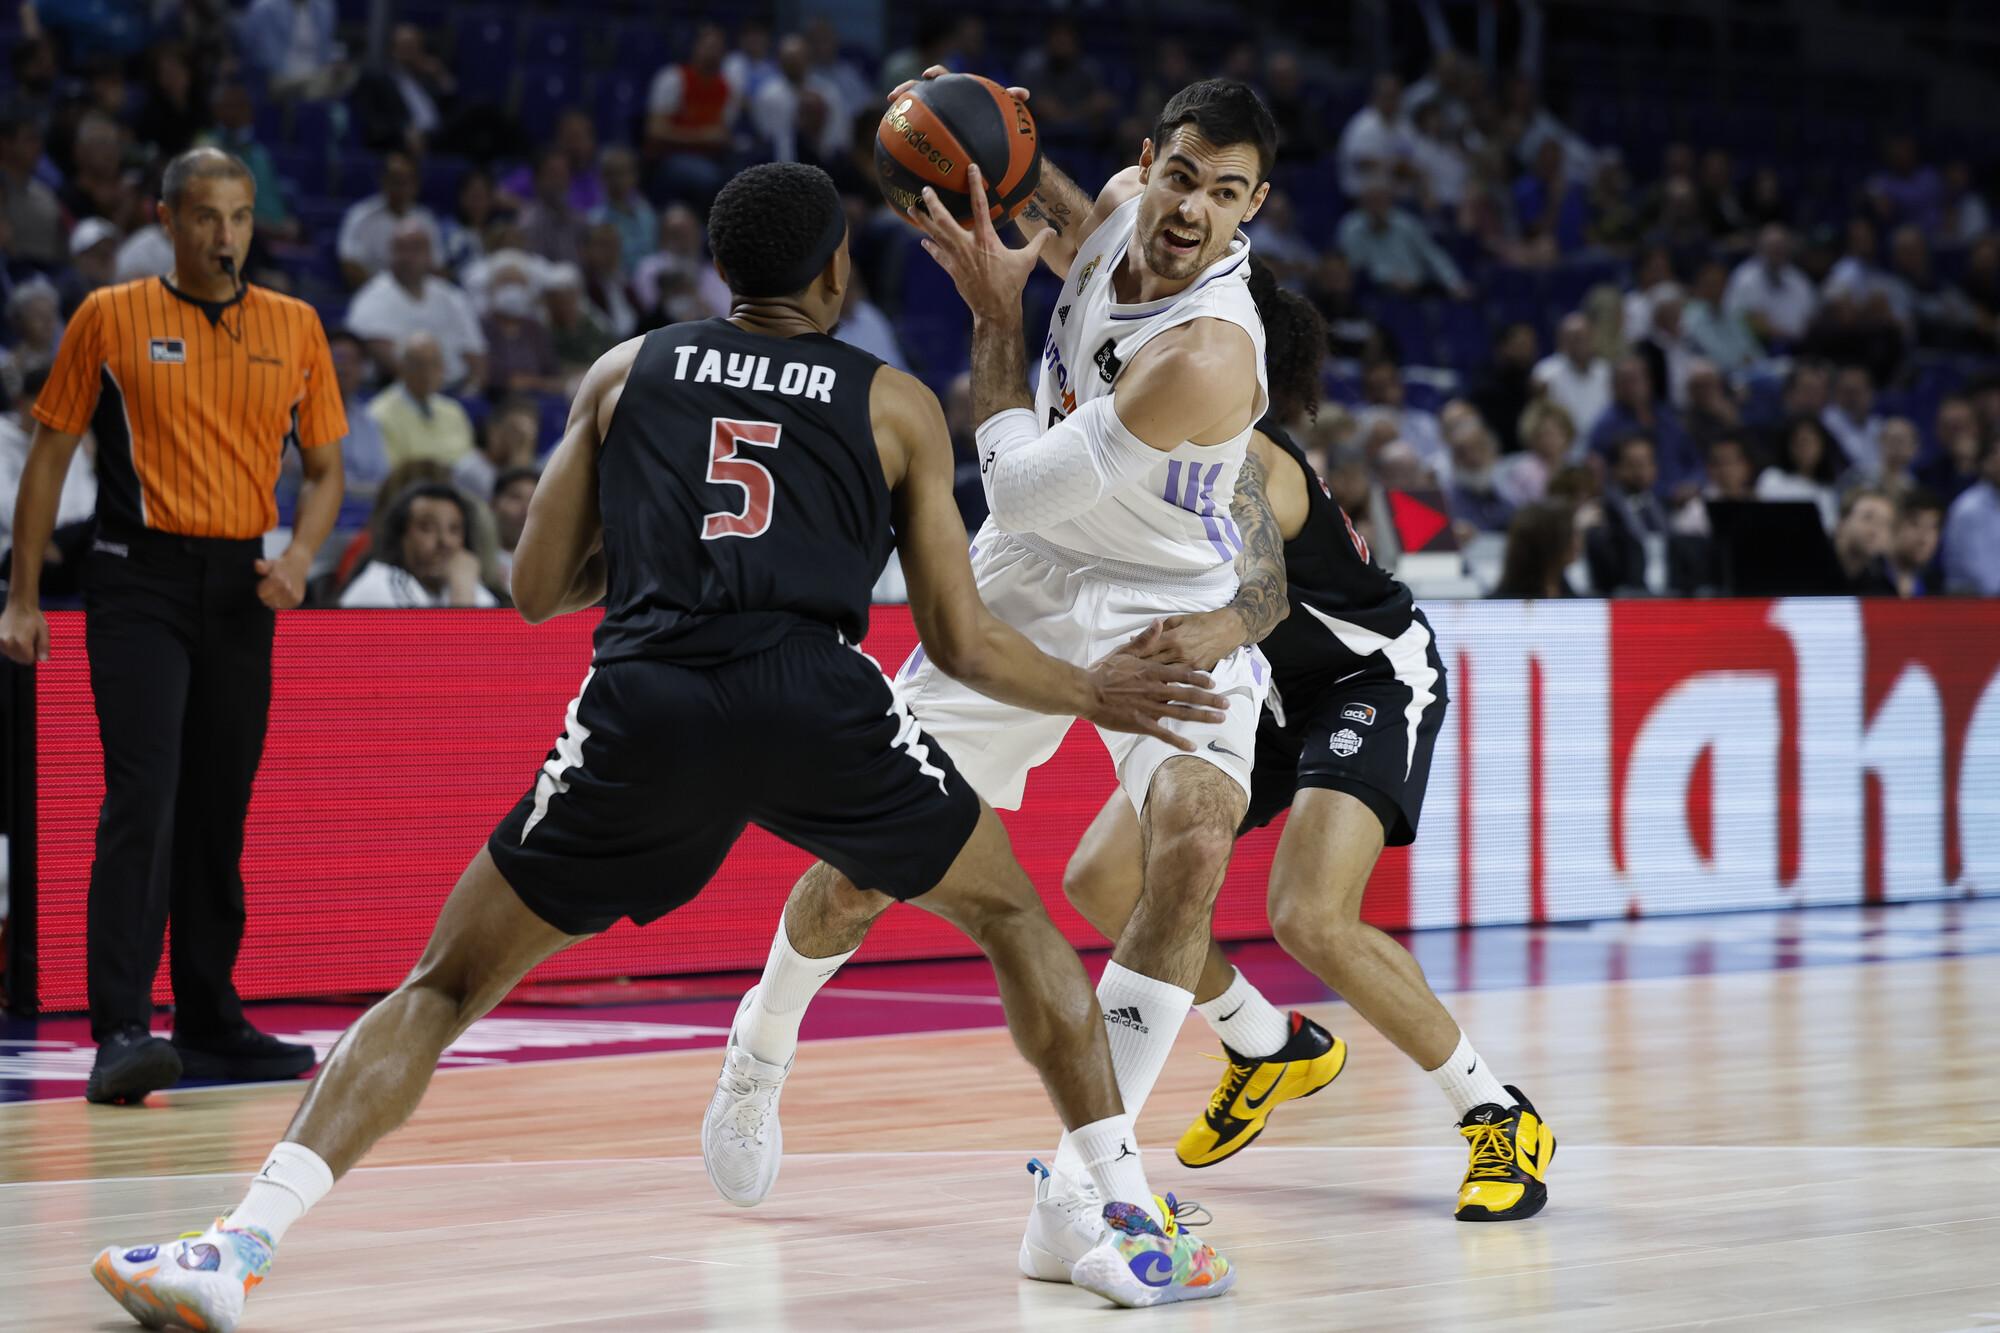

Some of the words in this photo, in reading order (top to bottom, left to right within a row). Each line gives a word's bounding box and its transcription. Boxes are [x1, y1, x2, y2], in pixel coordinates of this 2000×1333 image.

[674, 345, 837, 404] TAYLOR
[700, 417, 783, 540] 5
[1103, 1013, 1149, 1034] adidas
